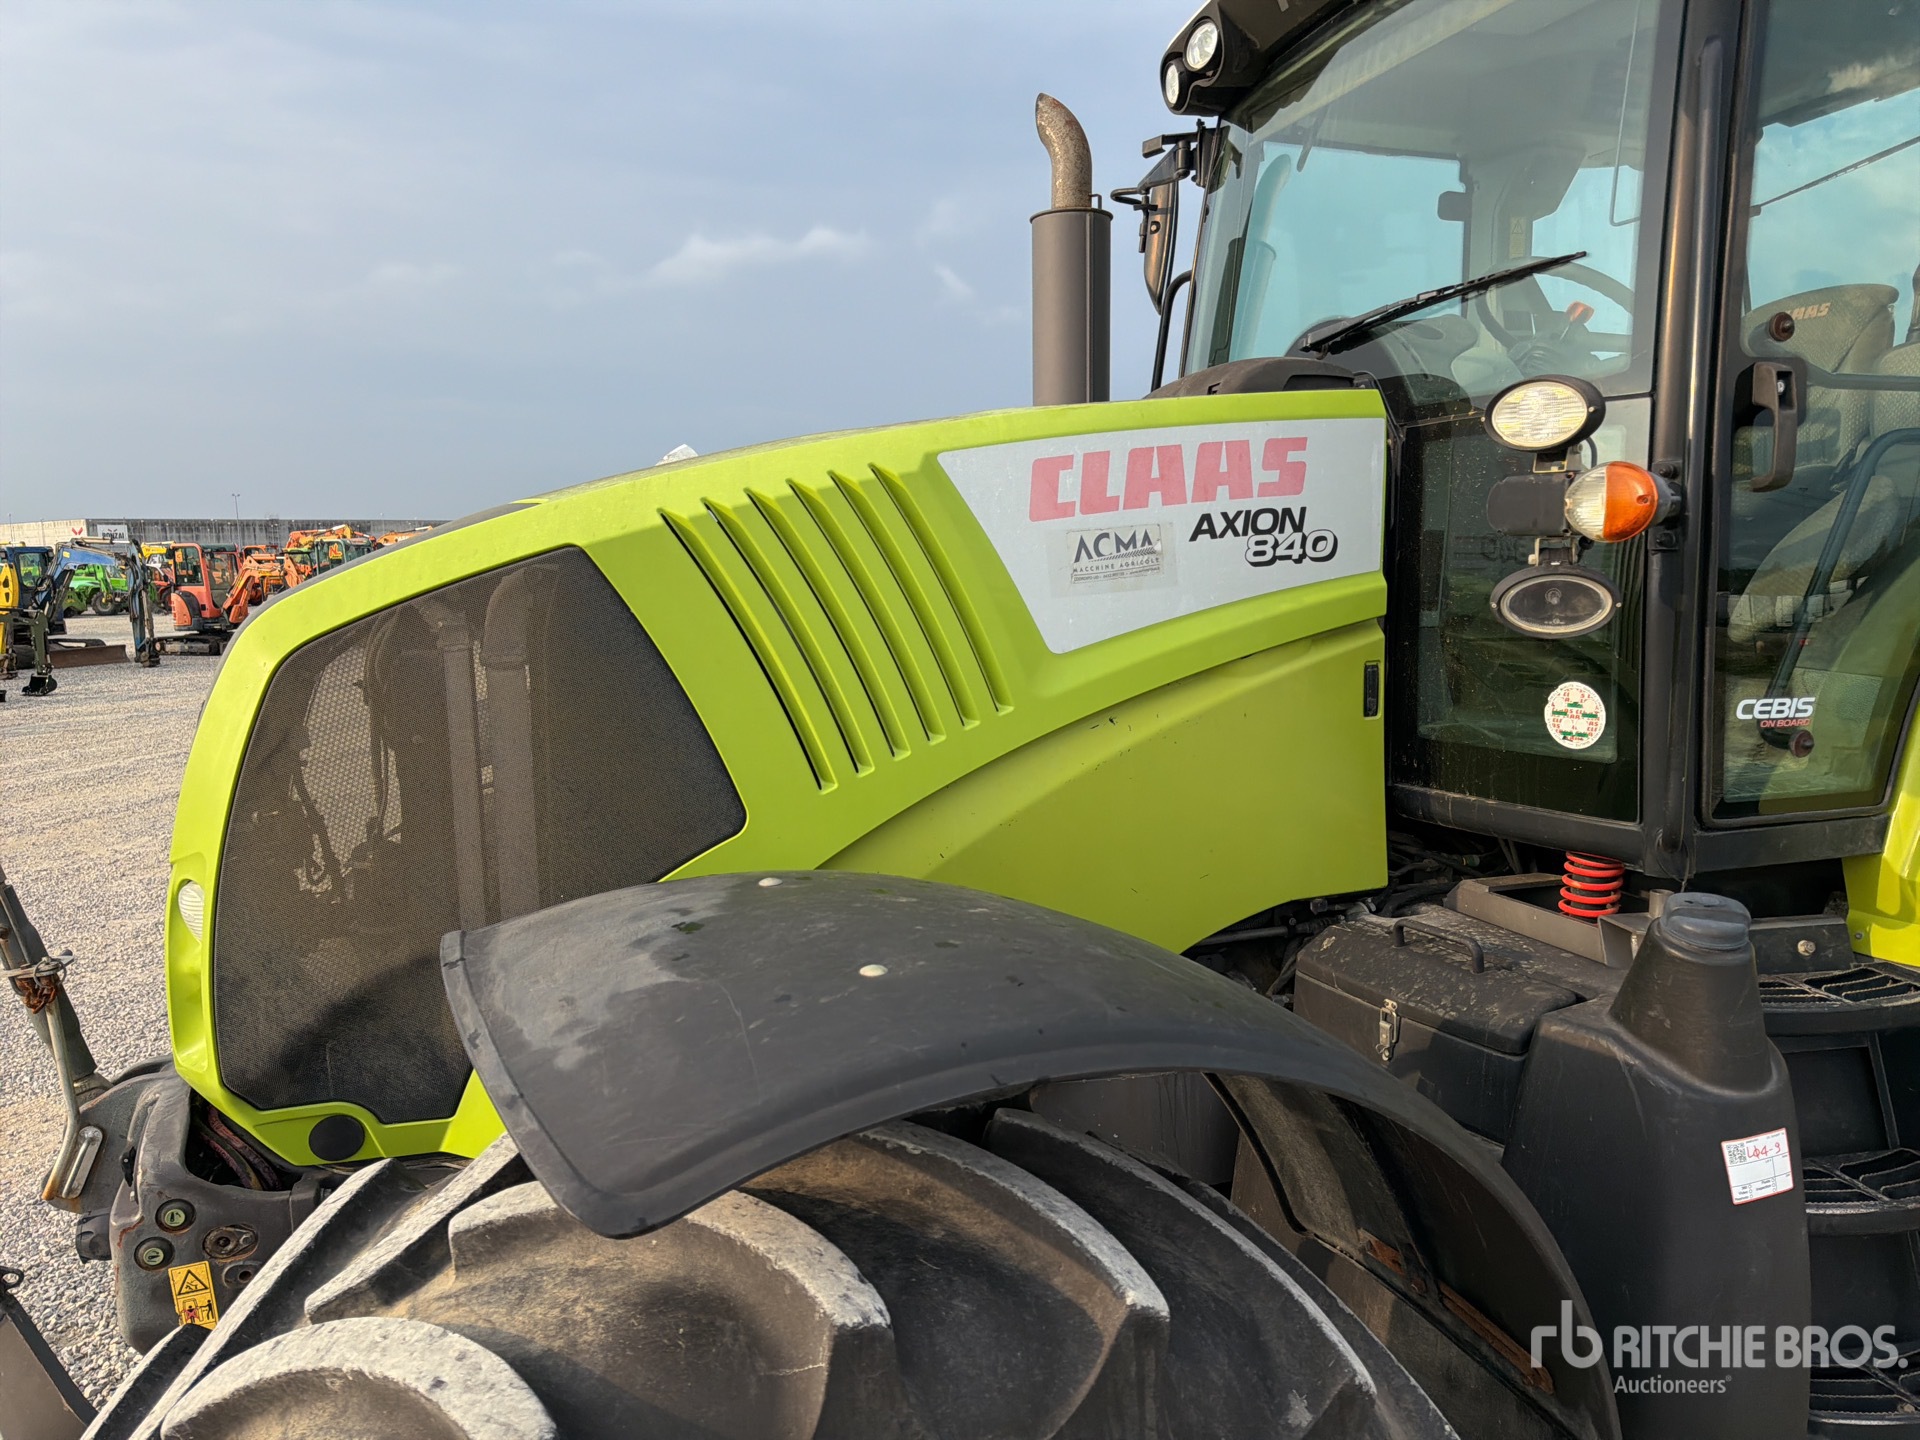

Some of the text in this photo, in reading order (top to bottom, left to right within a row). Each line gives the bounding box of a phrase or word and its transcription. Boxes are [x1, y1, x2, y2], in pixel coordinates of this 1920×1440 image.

[1785, 302, 1831, 320] AAS
[1029, 437, 1308, 522] CLAAS
[1189, 506, 1308, 542] AXION
[1073, 528, 1153, 563] ACMA
[1244, 529, 1339, 567] 840
[1073, 557, 1160, 573] MACCHINE AGRICOLE
[1735, 697, 1816, 720] CEBIS
[1760, 718, 1811, 728] ON BOARD
